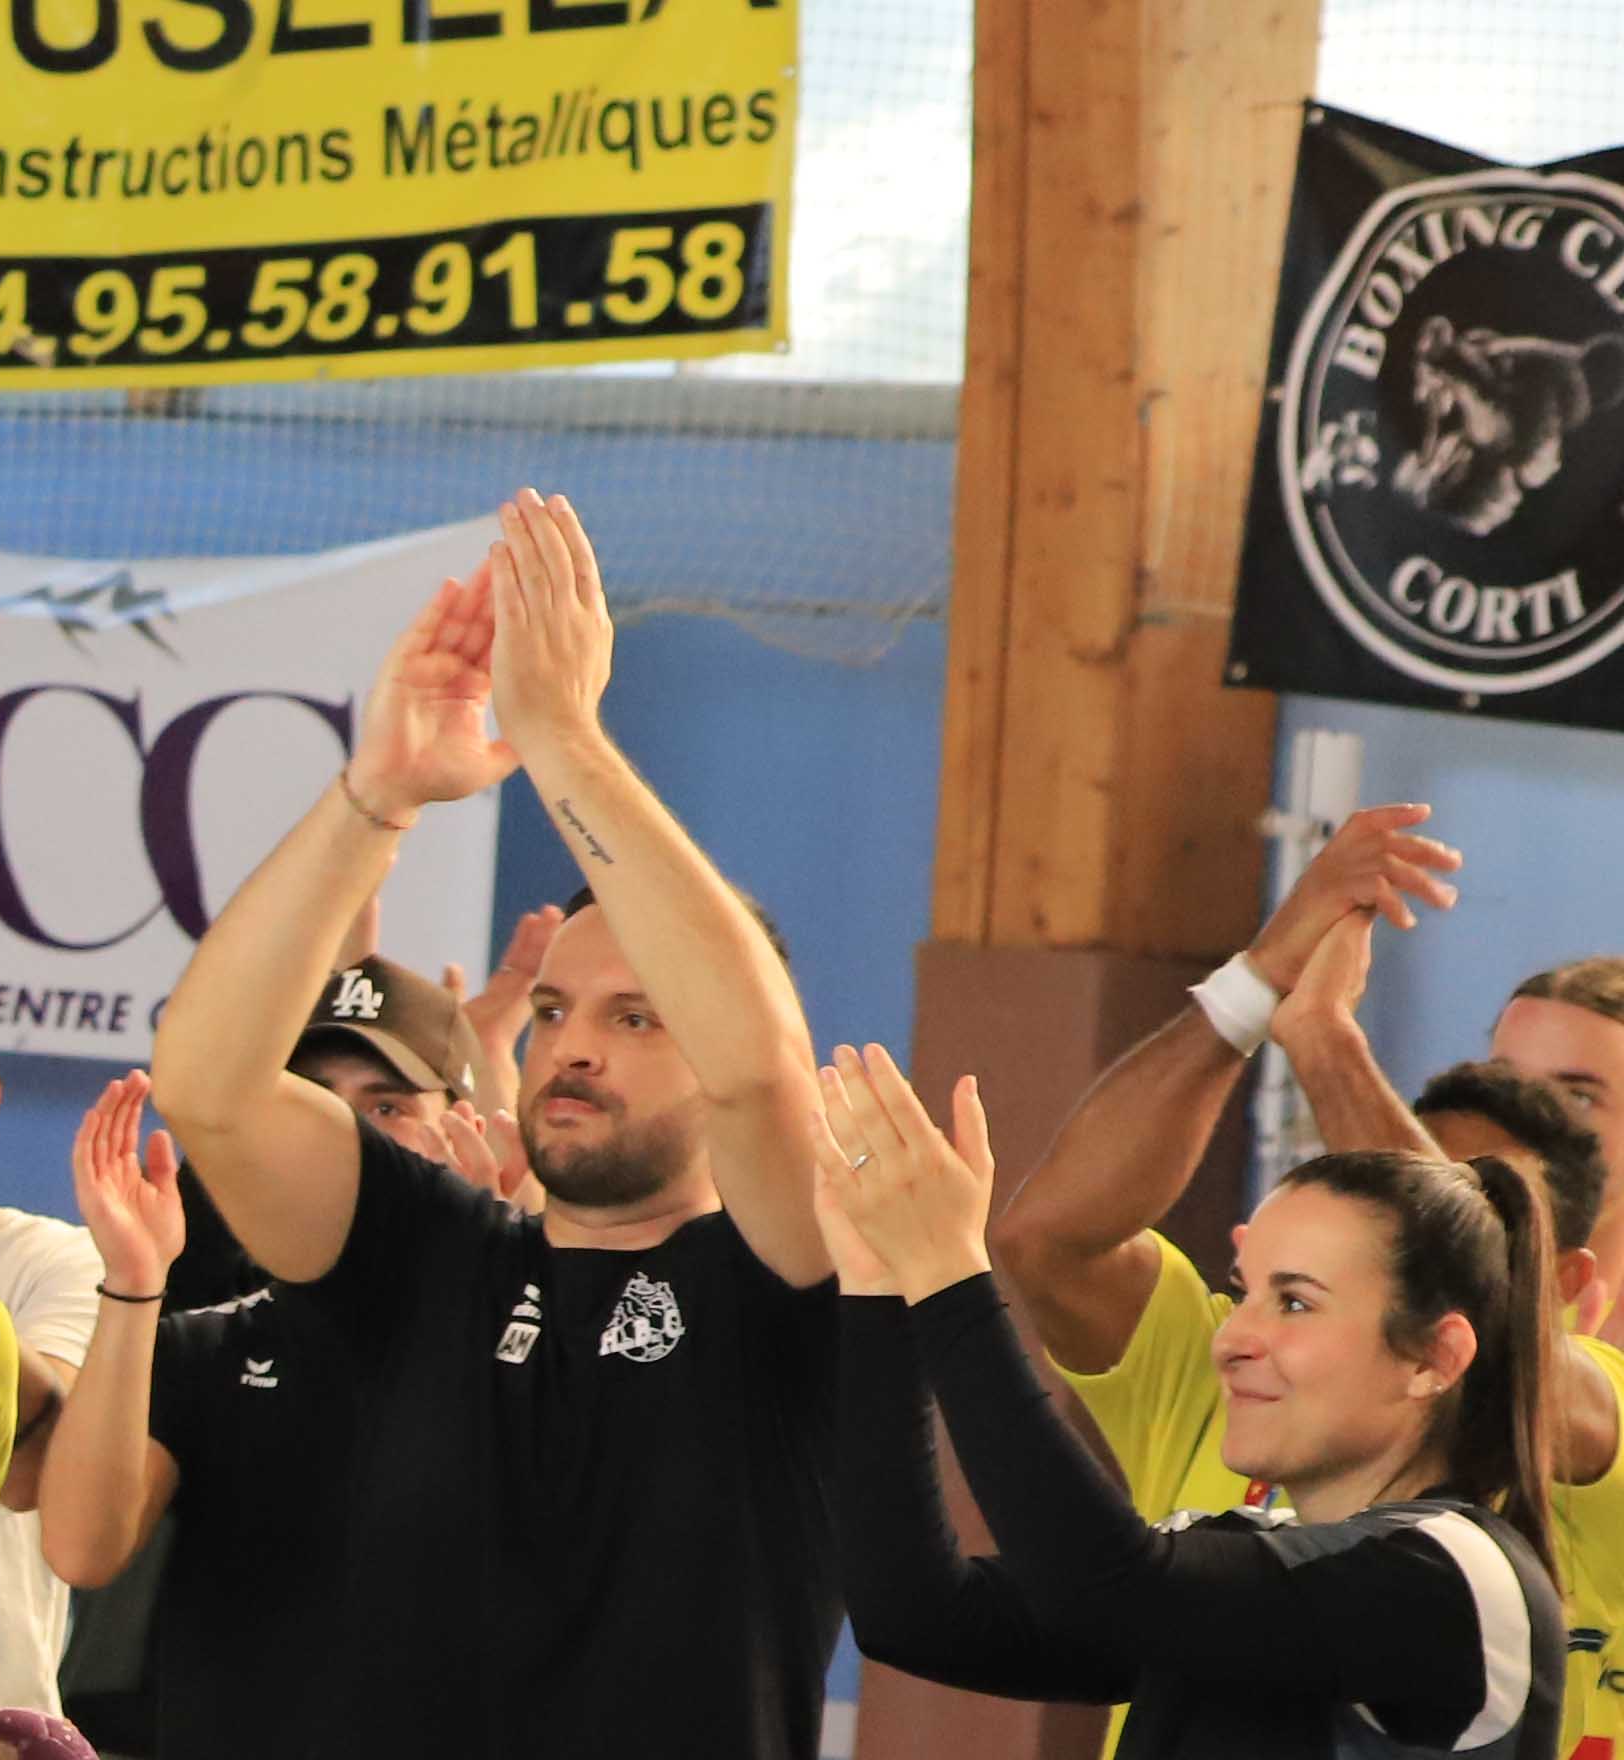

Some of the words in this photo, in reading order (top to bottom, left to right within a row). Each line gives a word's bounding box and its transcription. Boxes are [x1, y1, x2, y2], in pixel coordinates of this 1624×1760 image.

[383, 88, 778, 177] Métalliques
[1333, 204, 1554, 381] BOXING
[1388, 555, 1588, 643] CORTI
[332, 969, 384, 1019] LA
